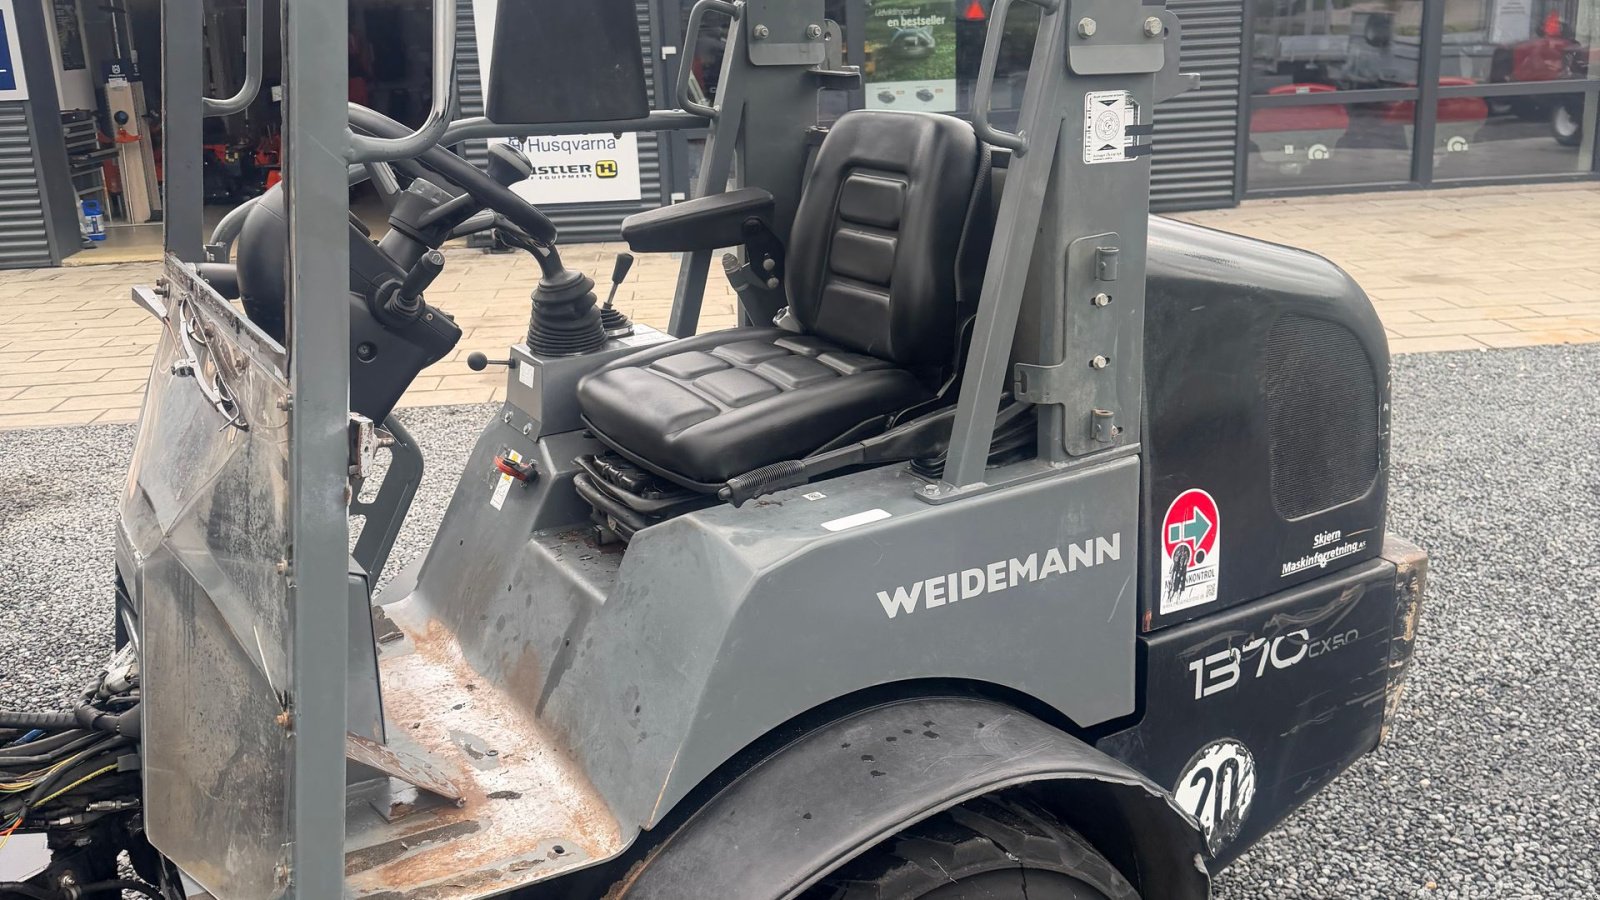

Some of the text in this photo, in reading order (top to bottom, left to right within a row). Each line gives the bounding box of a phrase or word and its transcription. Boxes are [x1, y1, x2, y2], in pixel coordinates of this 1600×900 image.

[887, 15, 946, 27] en bestseller
[528, 138, 616, 155] Husqvarna
[531, 164, 592, 175] STLER
[539, 173, 592, 181] EQUIPMENT
[1313, 530, 1341, 547] Skjern
[1282, 541, 1358, 575] Maskinforretning
[876, 532, 1121, 619] WEIDEMANN
[1189, 628, 1359, 700] 1370 CX50
[1190, 757, 1241, 825] 20
